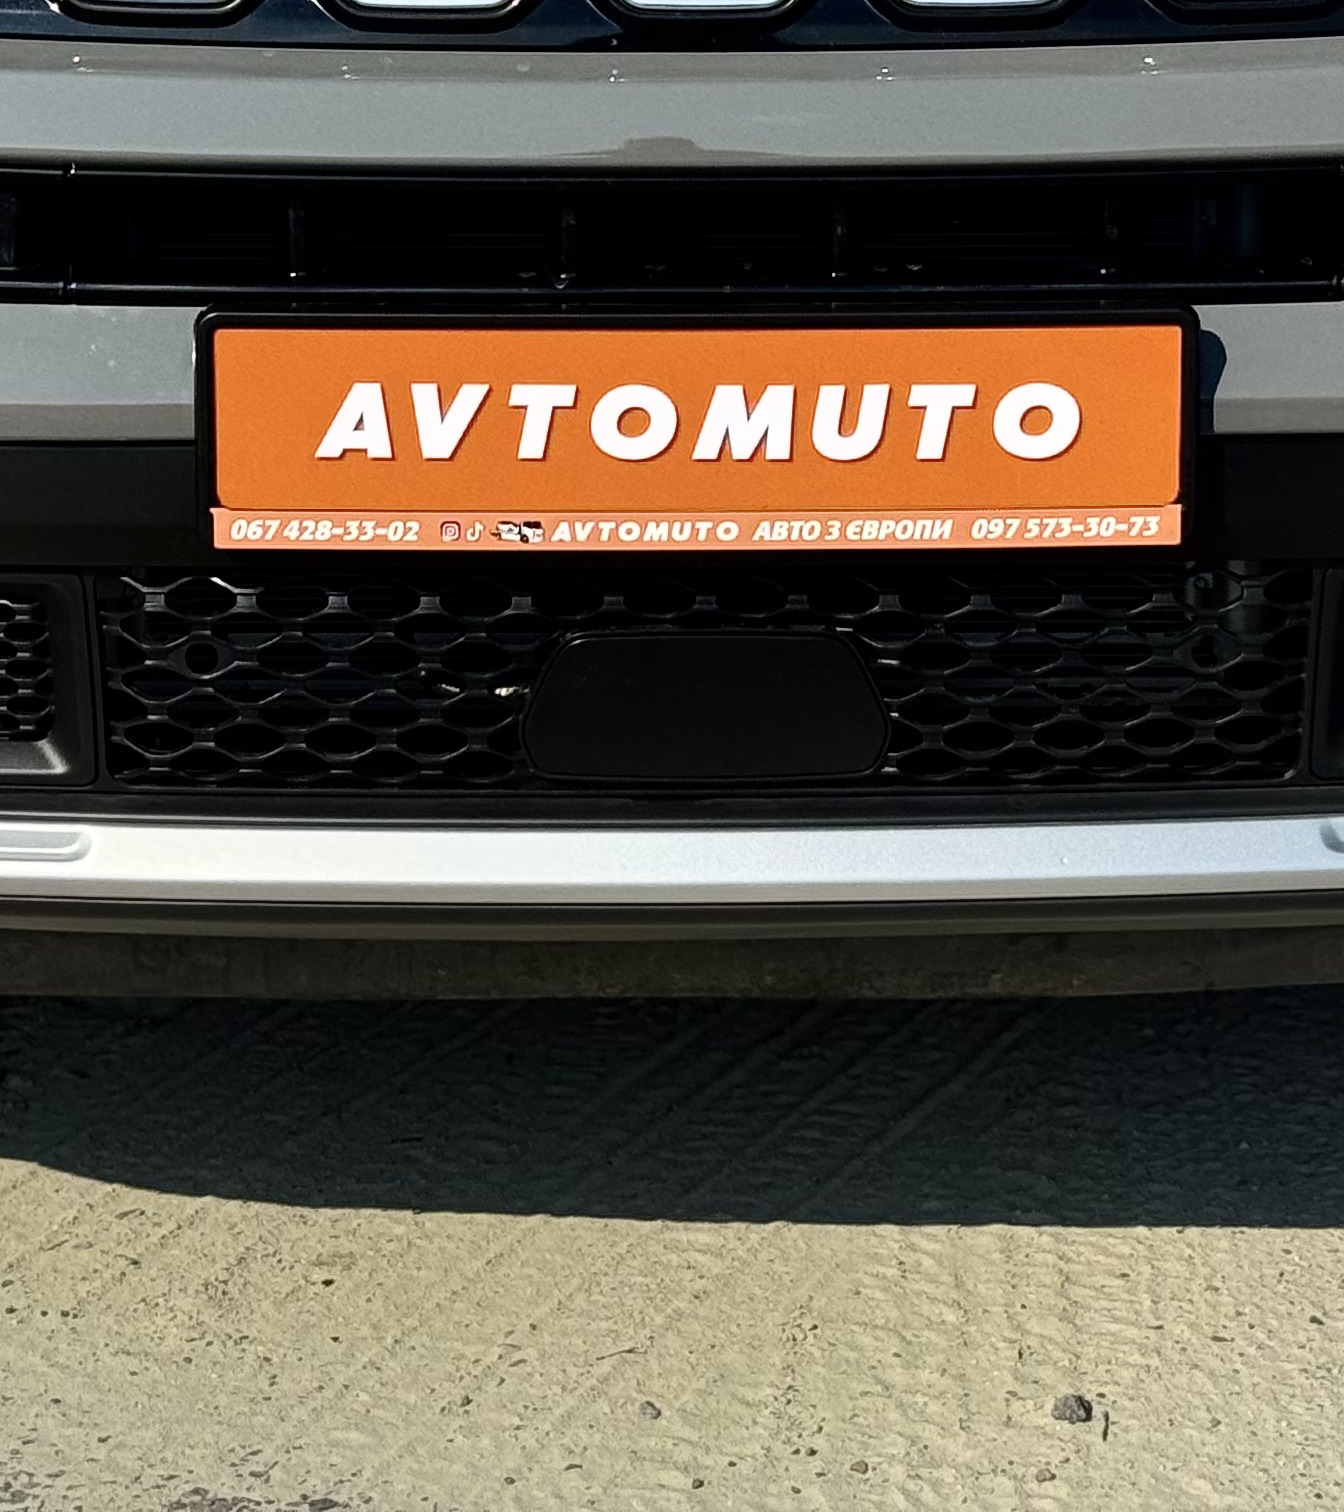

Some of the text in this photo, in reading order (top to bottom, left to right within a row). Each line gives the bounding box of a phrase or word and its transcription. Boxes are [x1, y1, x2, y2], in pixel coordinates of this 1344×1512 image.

[313, 381, 1084, 462] AVTOMUTO
[551, 521, 739, 542] AVTOMUTO
[752, 520, 821, 541] АВТО
[845, 519, 953, 540] ЄВРОПИ
